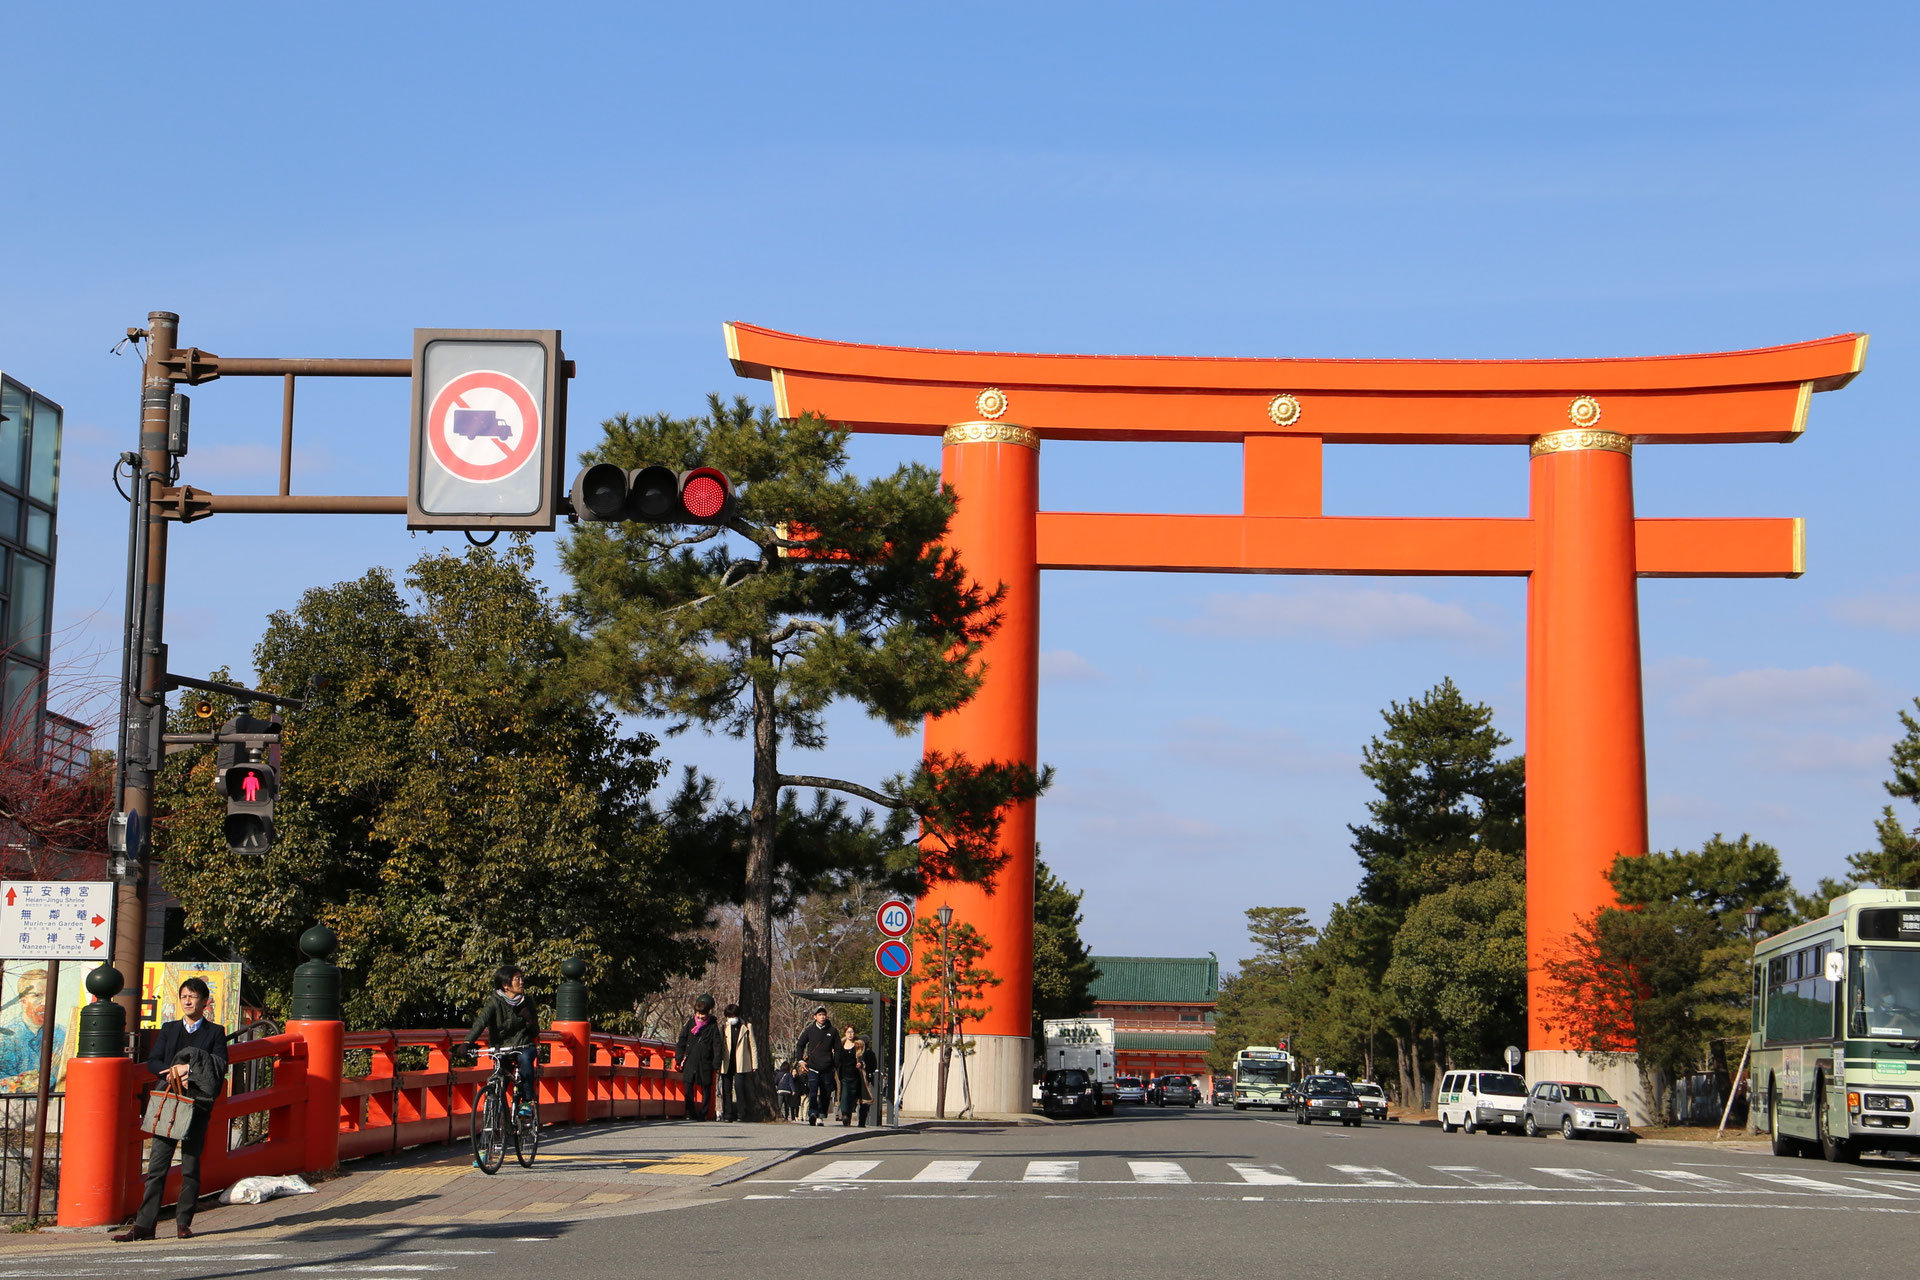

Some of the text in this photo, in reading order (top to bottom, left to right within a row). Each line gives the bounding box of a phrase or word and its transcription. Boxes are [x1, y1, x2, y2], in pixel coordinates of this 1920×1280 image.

[22, 886, 89, 897] 平安神宮
[885, 911, 905, 927] 40
[19, 933, 86, 943] 南禅寺
